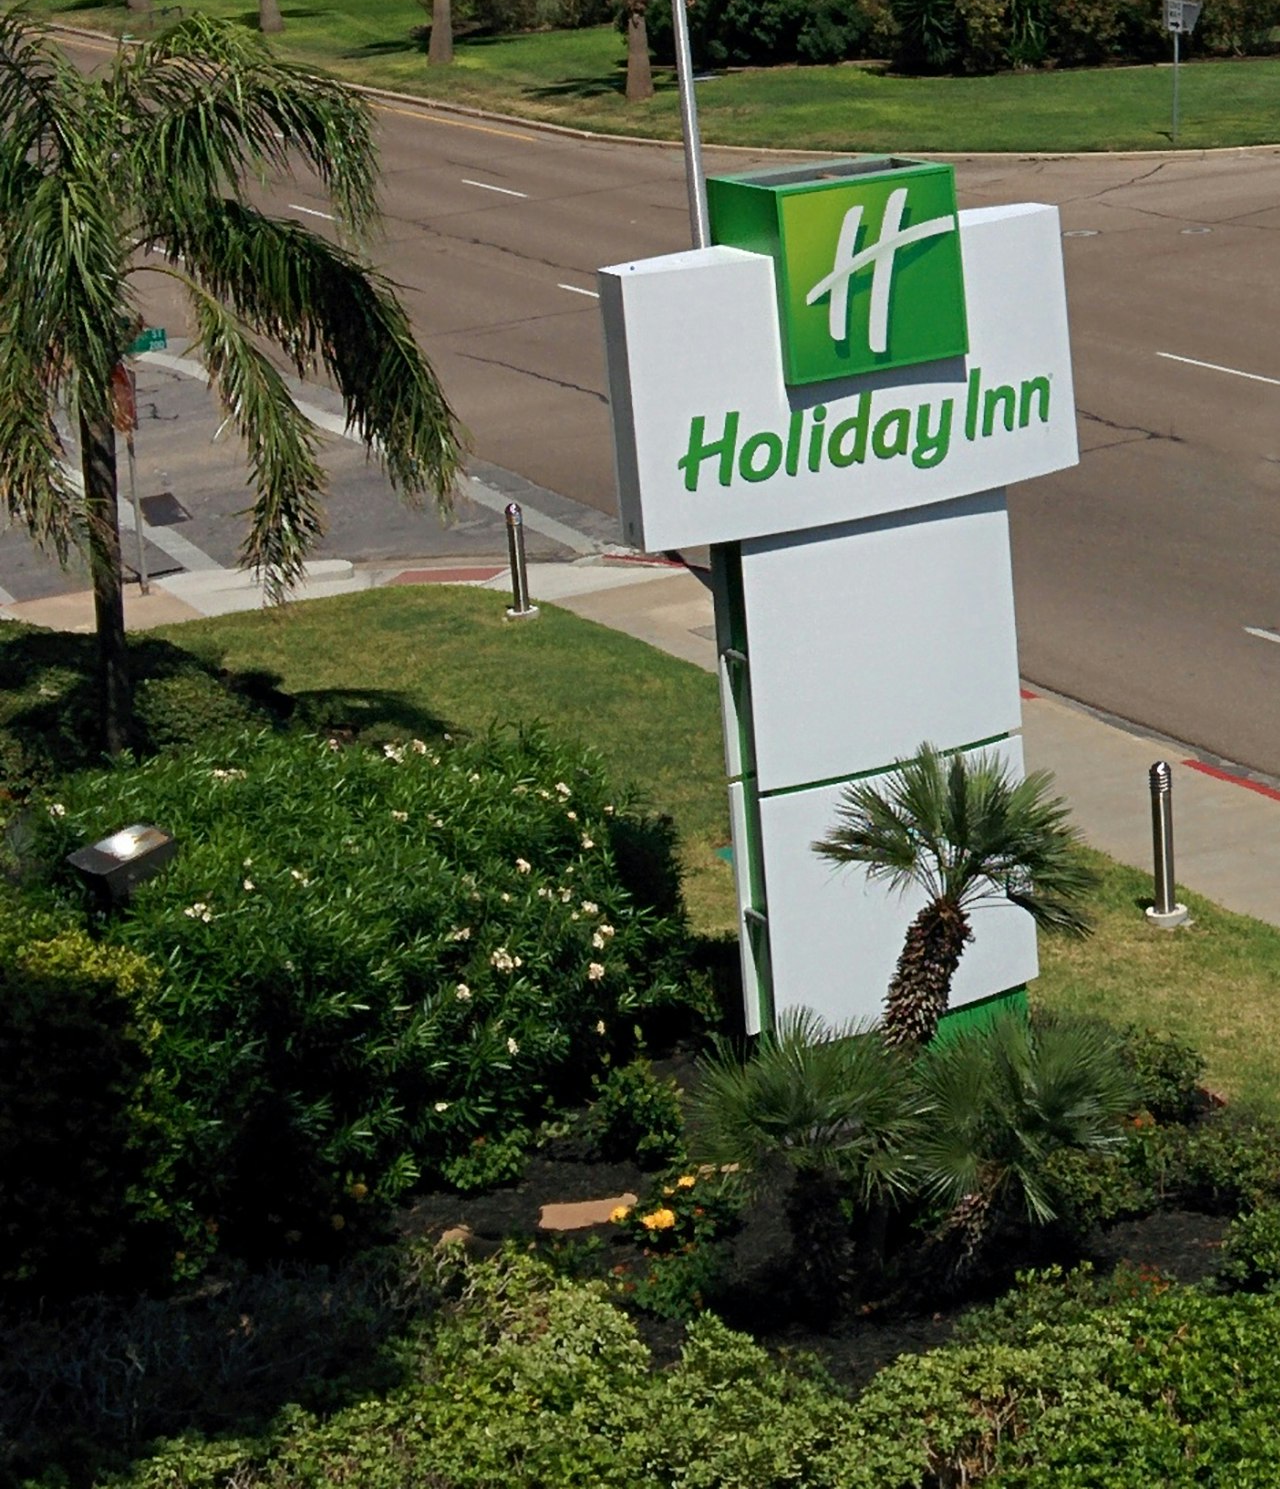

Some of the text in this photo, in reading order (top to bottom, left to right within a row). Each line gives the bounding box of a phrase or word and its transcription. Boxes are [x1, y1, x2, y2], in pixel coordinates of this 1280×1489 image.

[806, 188, 955, 353] H
[678, 367, 1051, 492] Holiday Inn
